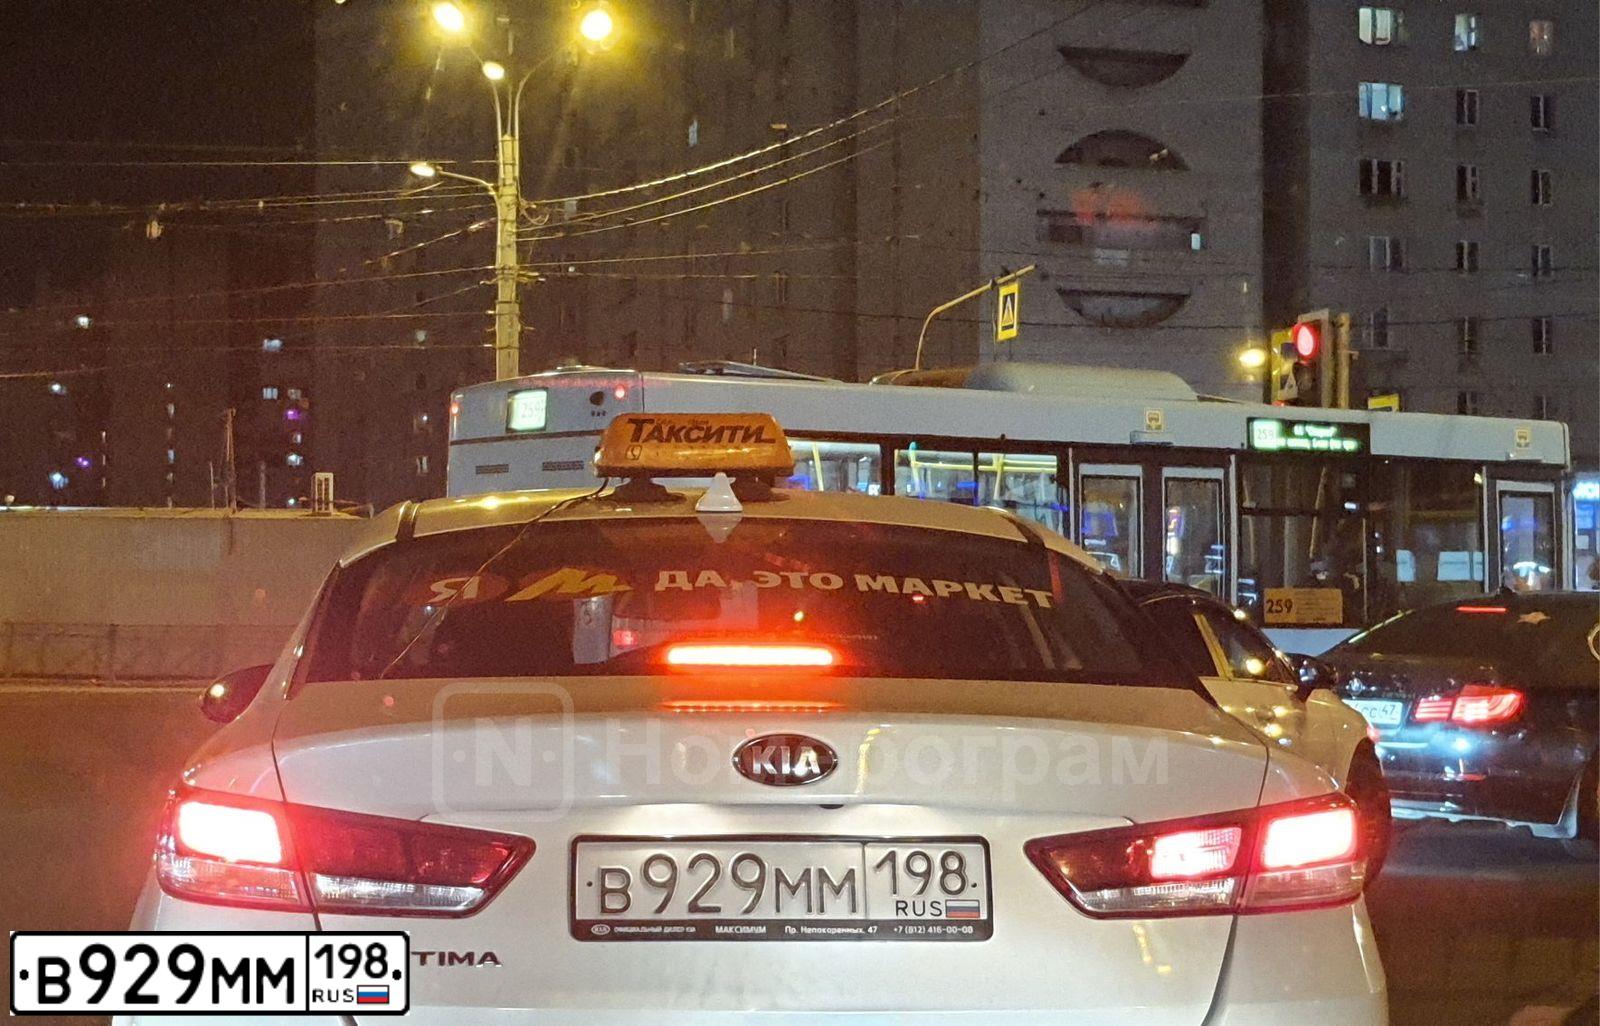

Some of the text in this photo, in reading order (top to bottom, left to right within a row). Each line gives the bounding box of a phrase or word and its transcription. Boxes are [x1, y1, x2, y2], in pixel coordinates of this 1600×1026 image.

[753, 570, 844, 589] ЭТО
[854, 574, 1053, 608] МАРКЕТ
[1265, 599, 1293, 613] 259
[752, 746, 820, 776] KIA
[600, 850, 966, 913] В929ММ 198
[895, 900, 943, 917] RUS
[715, 925, 767, 934] МАКСИМУМ
[867, 925, 878, 934] 47
[893, 926, 903, 934] +7
[904, 925, 926, 935] (812)
